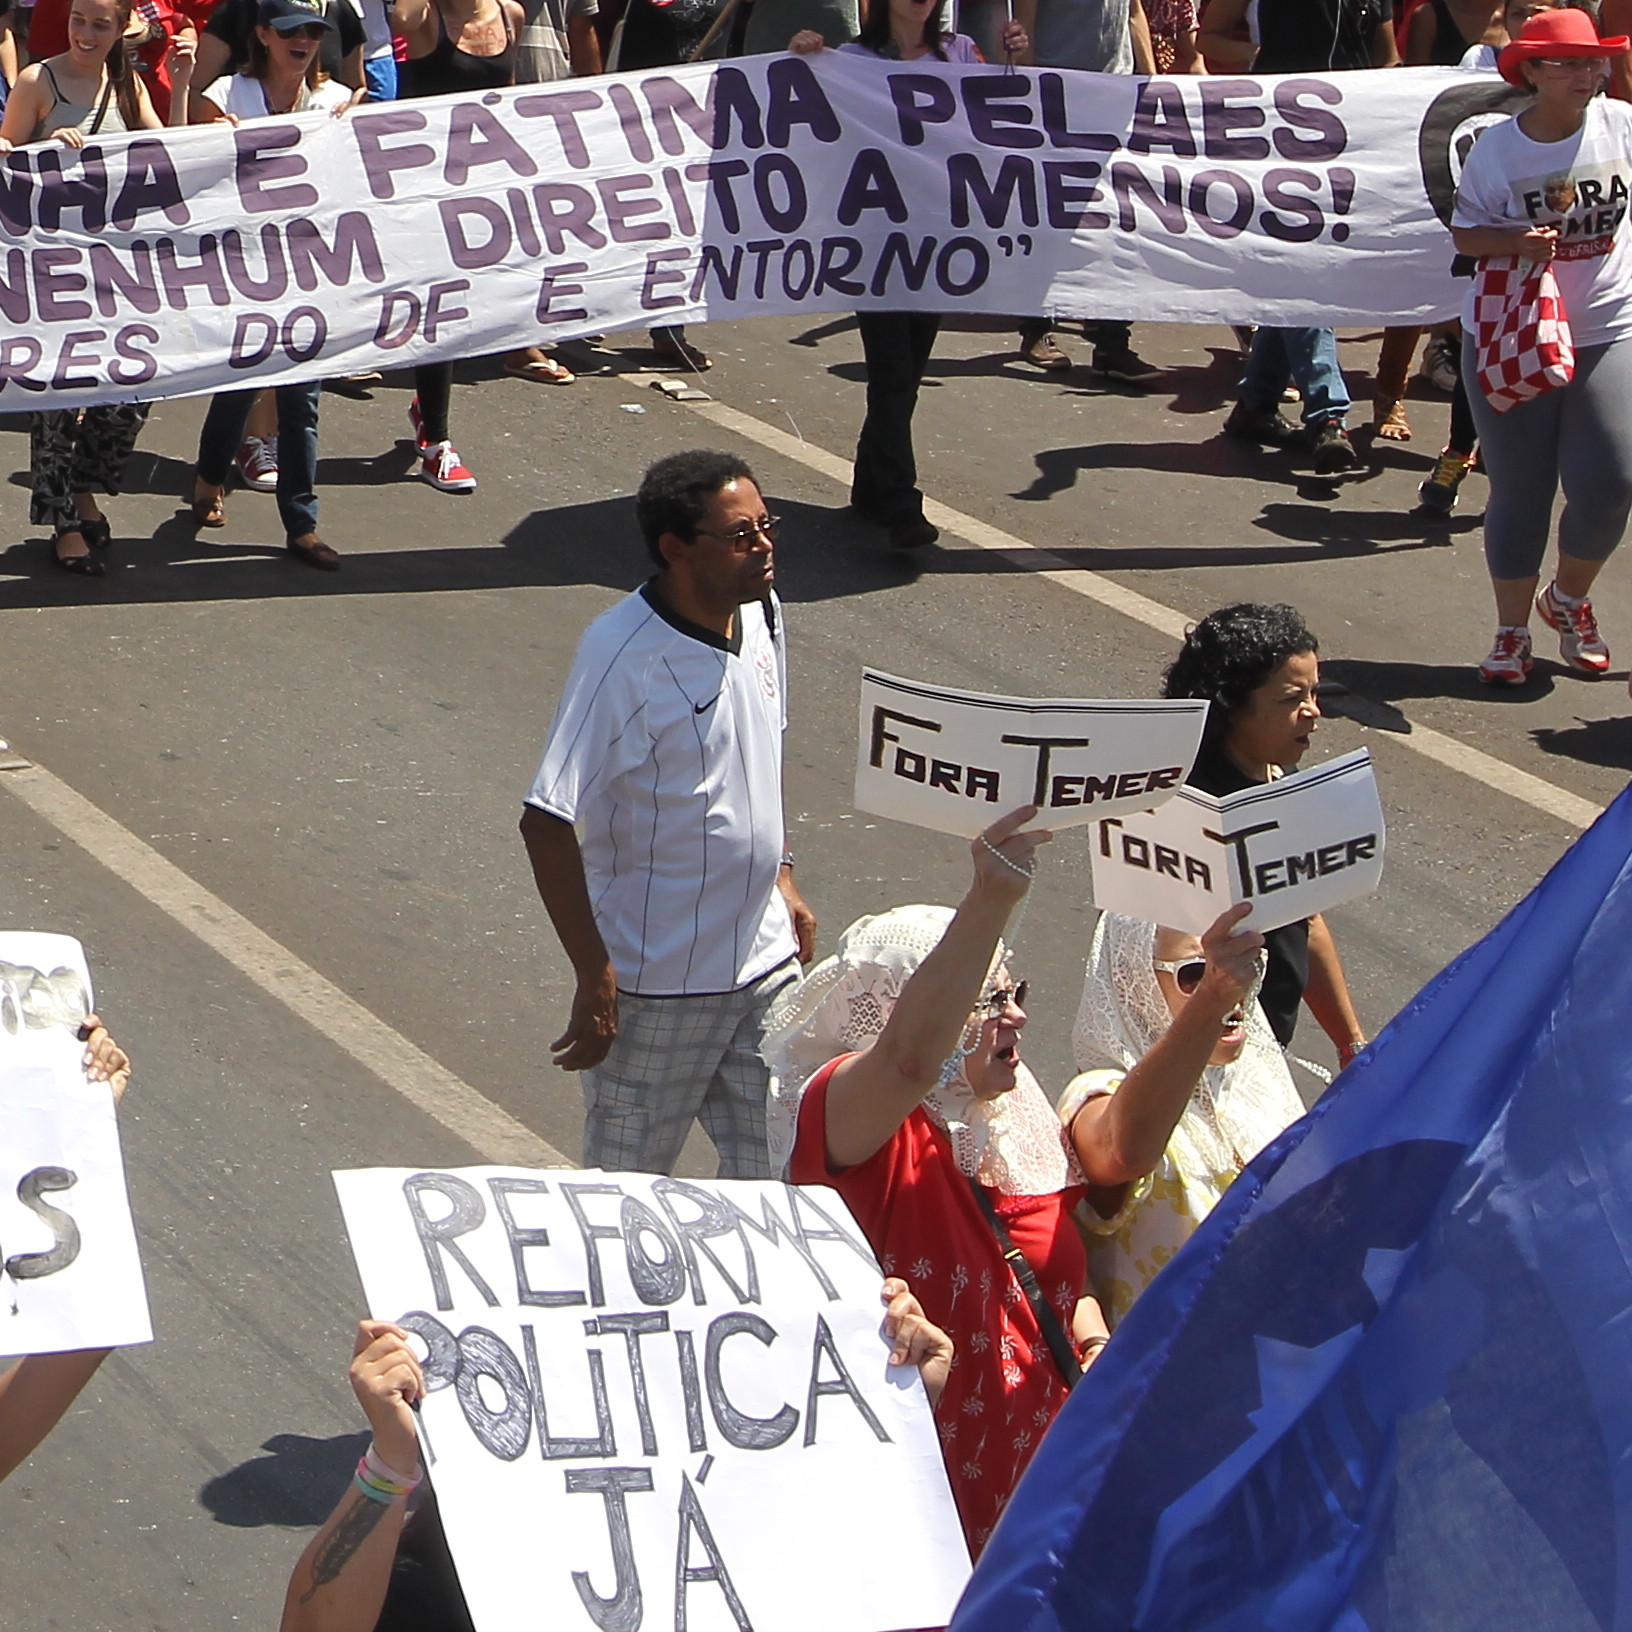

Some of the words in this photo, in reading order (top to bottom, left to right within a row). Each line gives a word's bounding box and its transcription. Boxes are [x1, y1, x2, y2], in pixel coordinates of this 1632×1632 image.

[234, 124, 321, 214] E
[351, 56, 842, 202] FÁTIMA
[888, 70, 1351, 162] PELAES
[441, 150, 809, 273] DIREITO
[836, 148, 910, 228] A
[945, 151, 1358, 244] MENOS!
[229, 302, 327, 368] DO
[374, 276, 472, 352] DF
[532, 258, 592, 325] E
[868, 703, 1003, 805] FORA
[1001, 736, 1184, 812] TEMER
[1202, 819, 1379, 901] TEMER
[402, 1170, 901, 1311] REFORMA
[568, 1453, 756, 1632] JÁ
